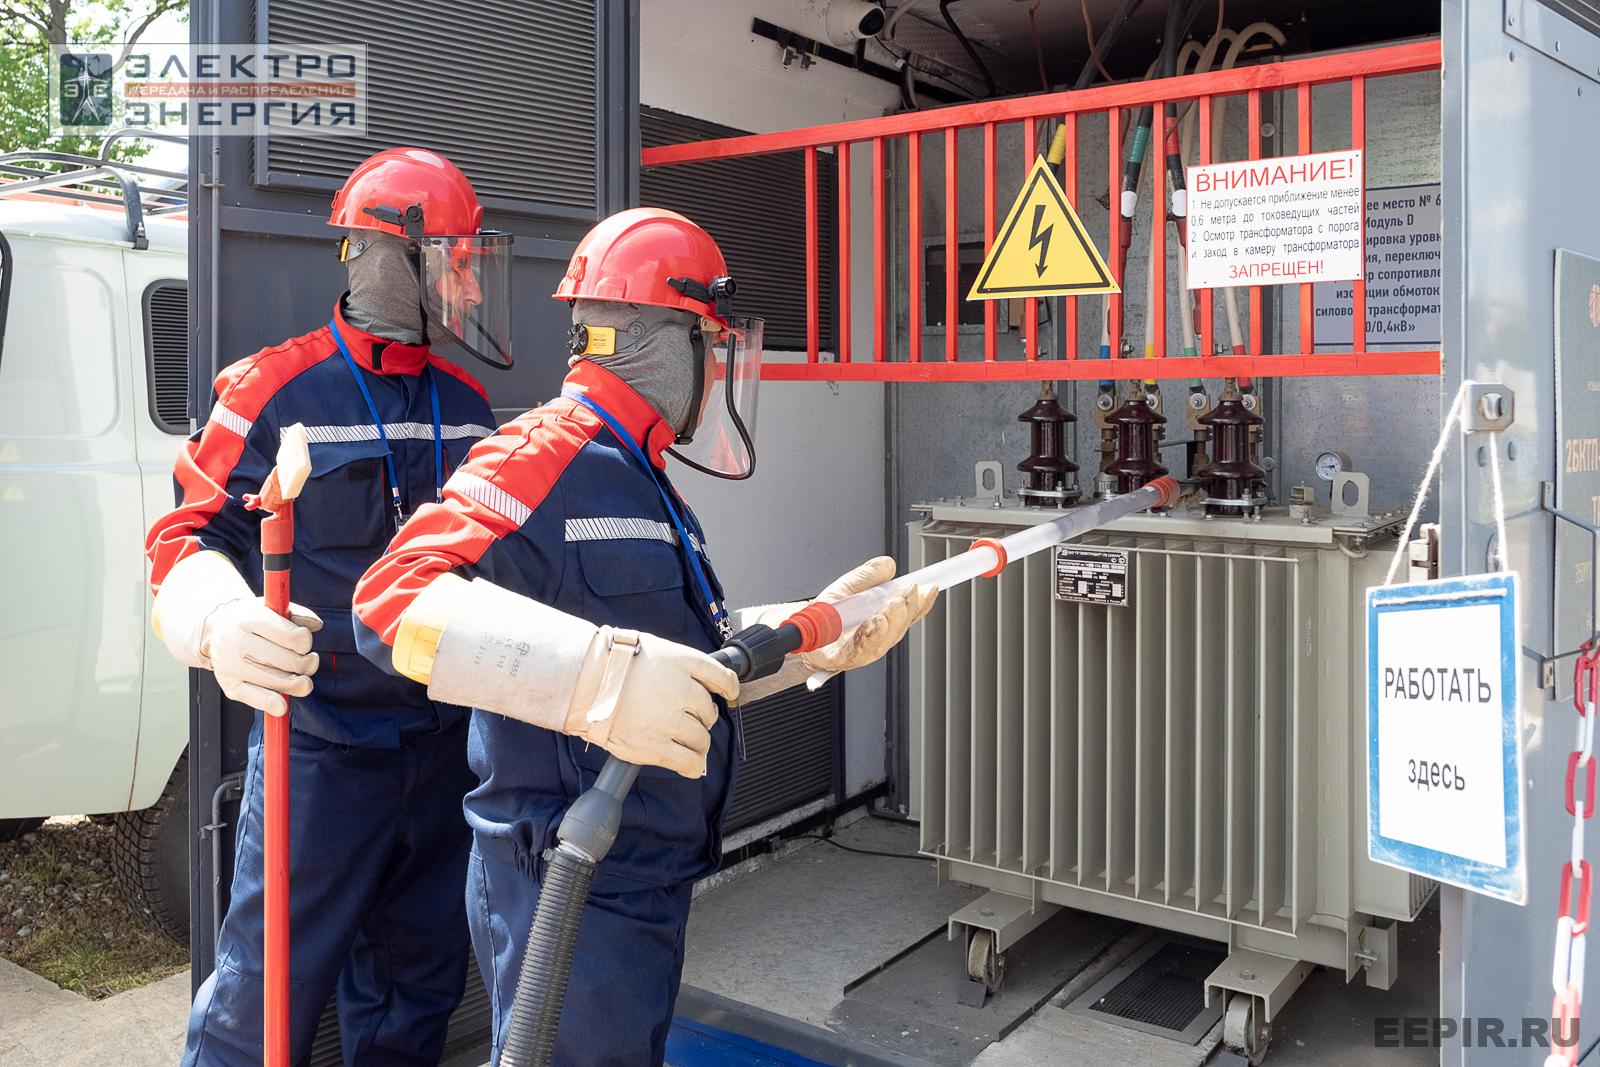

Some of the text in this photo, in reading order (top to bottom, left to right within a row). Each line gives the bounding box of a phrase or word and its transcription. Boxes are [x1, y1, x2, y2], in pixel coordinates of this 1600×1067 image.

[1196, 158, 1353, 192] ВНИМАНИЕ!
[1200, 200, 1212, 209] Не
[1213, 195, 1266, 210] допускается
[1268, 190, 1328, 205] приближение
[1330, 187, 1360, 198] менее
[1382, 198, 1416, 210] место
[1210, 214, 1237, 226] метра
[1243, 213, 1254, 224] до
[1261, 208, 1320, 221] токоведущих
[1327, 202, 1360, 216] частей
[1203, 230, 1235, 242] Осмотр
[1240, 225, 1313, 241] трансформатора
[1317, 224, 1324, 234] с
[1328, 221, 1360, 235] порога
[1366, 235, 1406, 248] ировка
[1203, 248, 1227, 259] заход
[1233, 247, 1239, 256] в
[1244, 244, 1276, 257] камеру
[1283, 239, 1360, 255] трансформатора
[1385, 250, 1441, 265] переключ
[1228, 260, 1324, 279] ЗАПРЕЩЕН!
[1393, 284, 1440, 297] обмоток
[1368, 302, 1441, 317] трансформат
[1385, 667, 1491, 703] РАБОТАТЬ
[1408, 759, 1465, 792] здесь
